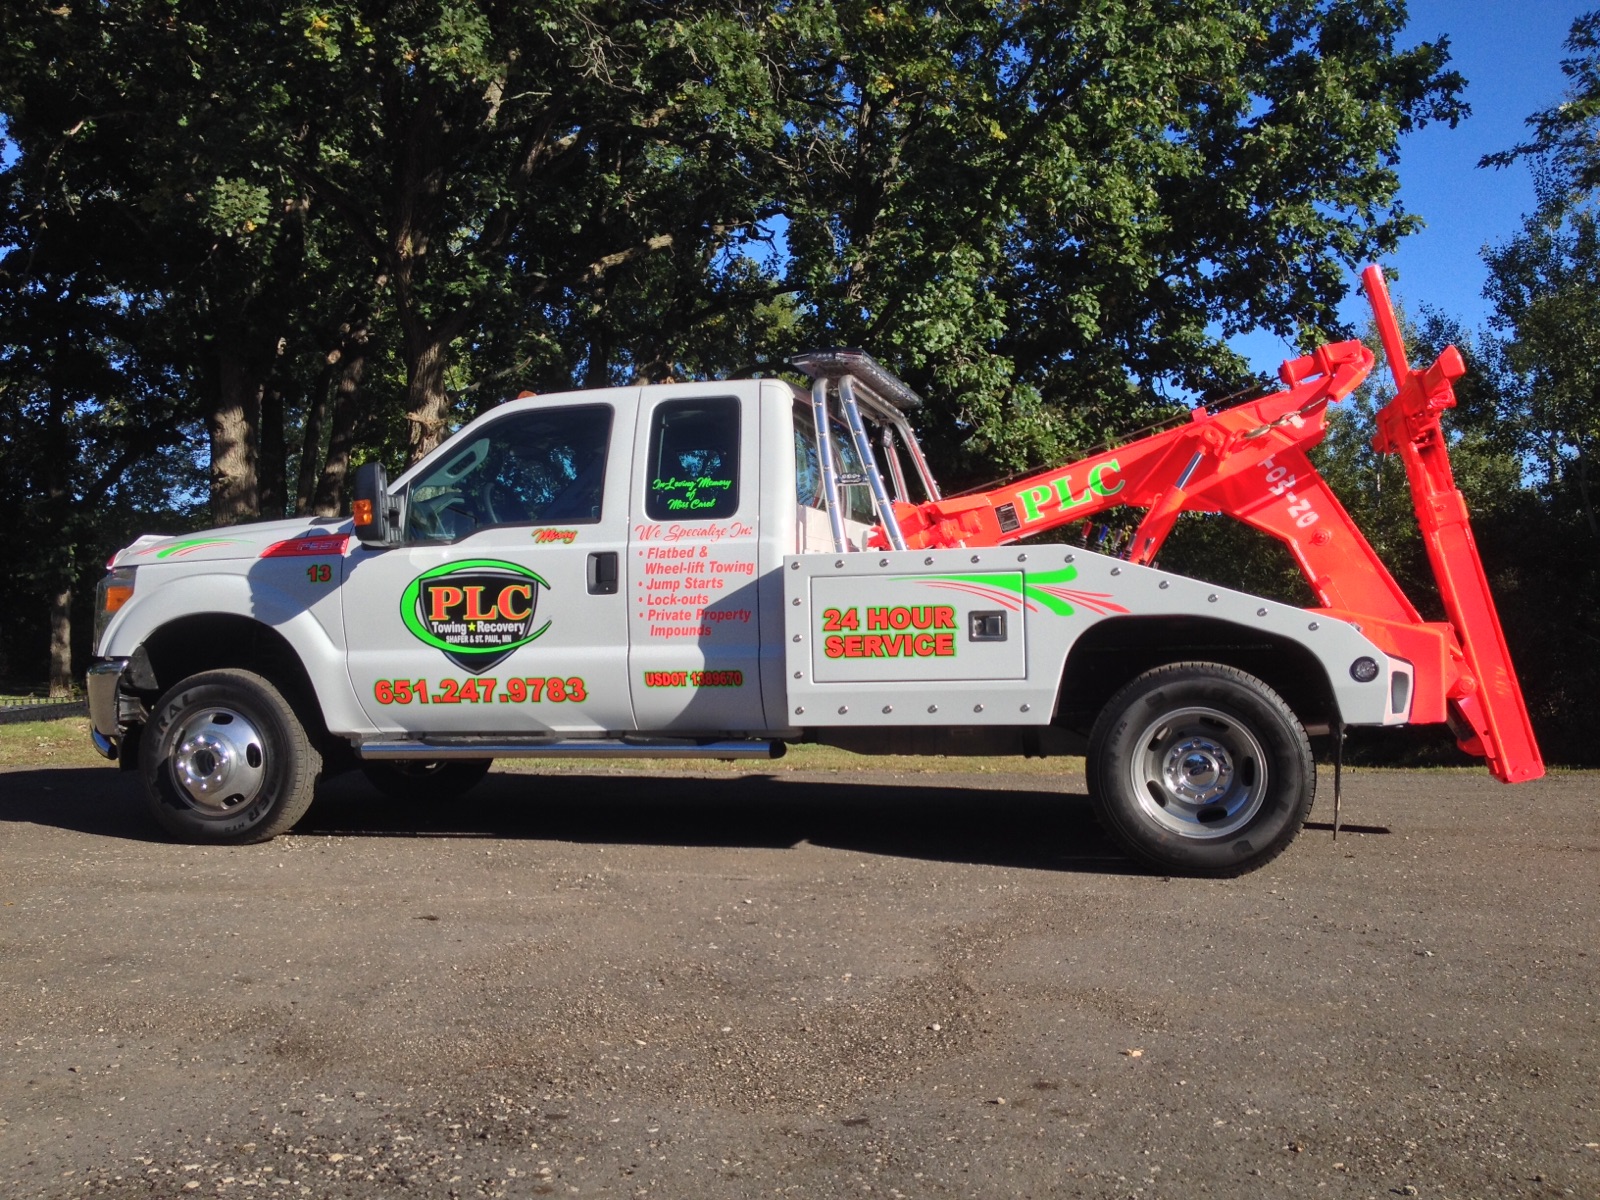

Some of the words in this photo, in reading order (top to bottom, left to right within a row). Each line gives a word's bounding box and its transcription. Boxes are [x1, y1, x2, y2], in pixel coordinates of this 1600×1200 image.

[664, 477, 696, 491] Loving
[697, 477, 732, 490] Memory
[1015, 458, 1126, 523] PLC
[1257, 453, 1319, 528] TOWING
[686, 488, 697, 501] of
[667, 499, 689, 510] Miss
[634, 524, 661, 541] We
[663, 523, 728, 543] Specialize
[729, 522, 753, 538] In:
[647, 545, 695, 559] Flatbed
[699, 545, 708, 558] &
[307, 563, 332, 583] 13
[645, 561, 704, 575] Wheel-lift
[709, 560, 755, 575] Towing
[646, 578, 681, 592] Jump
[684, 577, 724, 590] Starts
[428, 584, 532, 621] PLC
[646, 593, 709, 606] Lock-outs
[647, 608, 692, 621] Private
[695, 608, 752, 624] Property
[822, 607, 860, 632] 24
[866, 605, 959, 631] HOUR
[432, 621, 467, 635] Towing
[477, 620, 525, 635] Recovery
[650, 624, 712, 639] Impounds
[446, 635, 469, 644] SHAFER
[823, 632, 958, 659] SERVICE
[644, 670, 688, 687] USDOT
[374, 677, 588, 705] 651.247.9783
